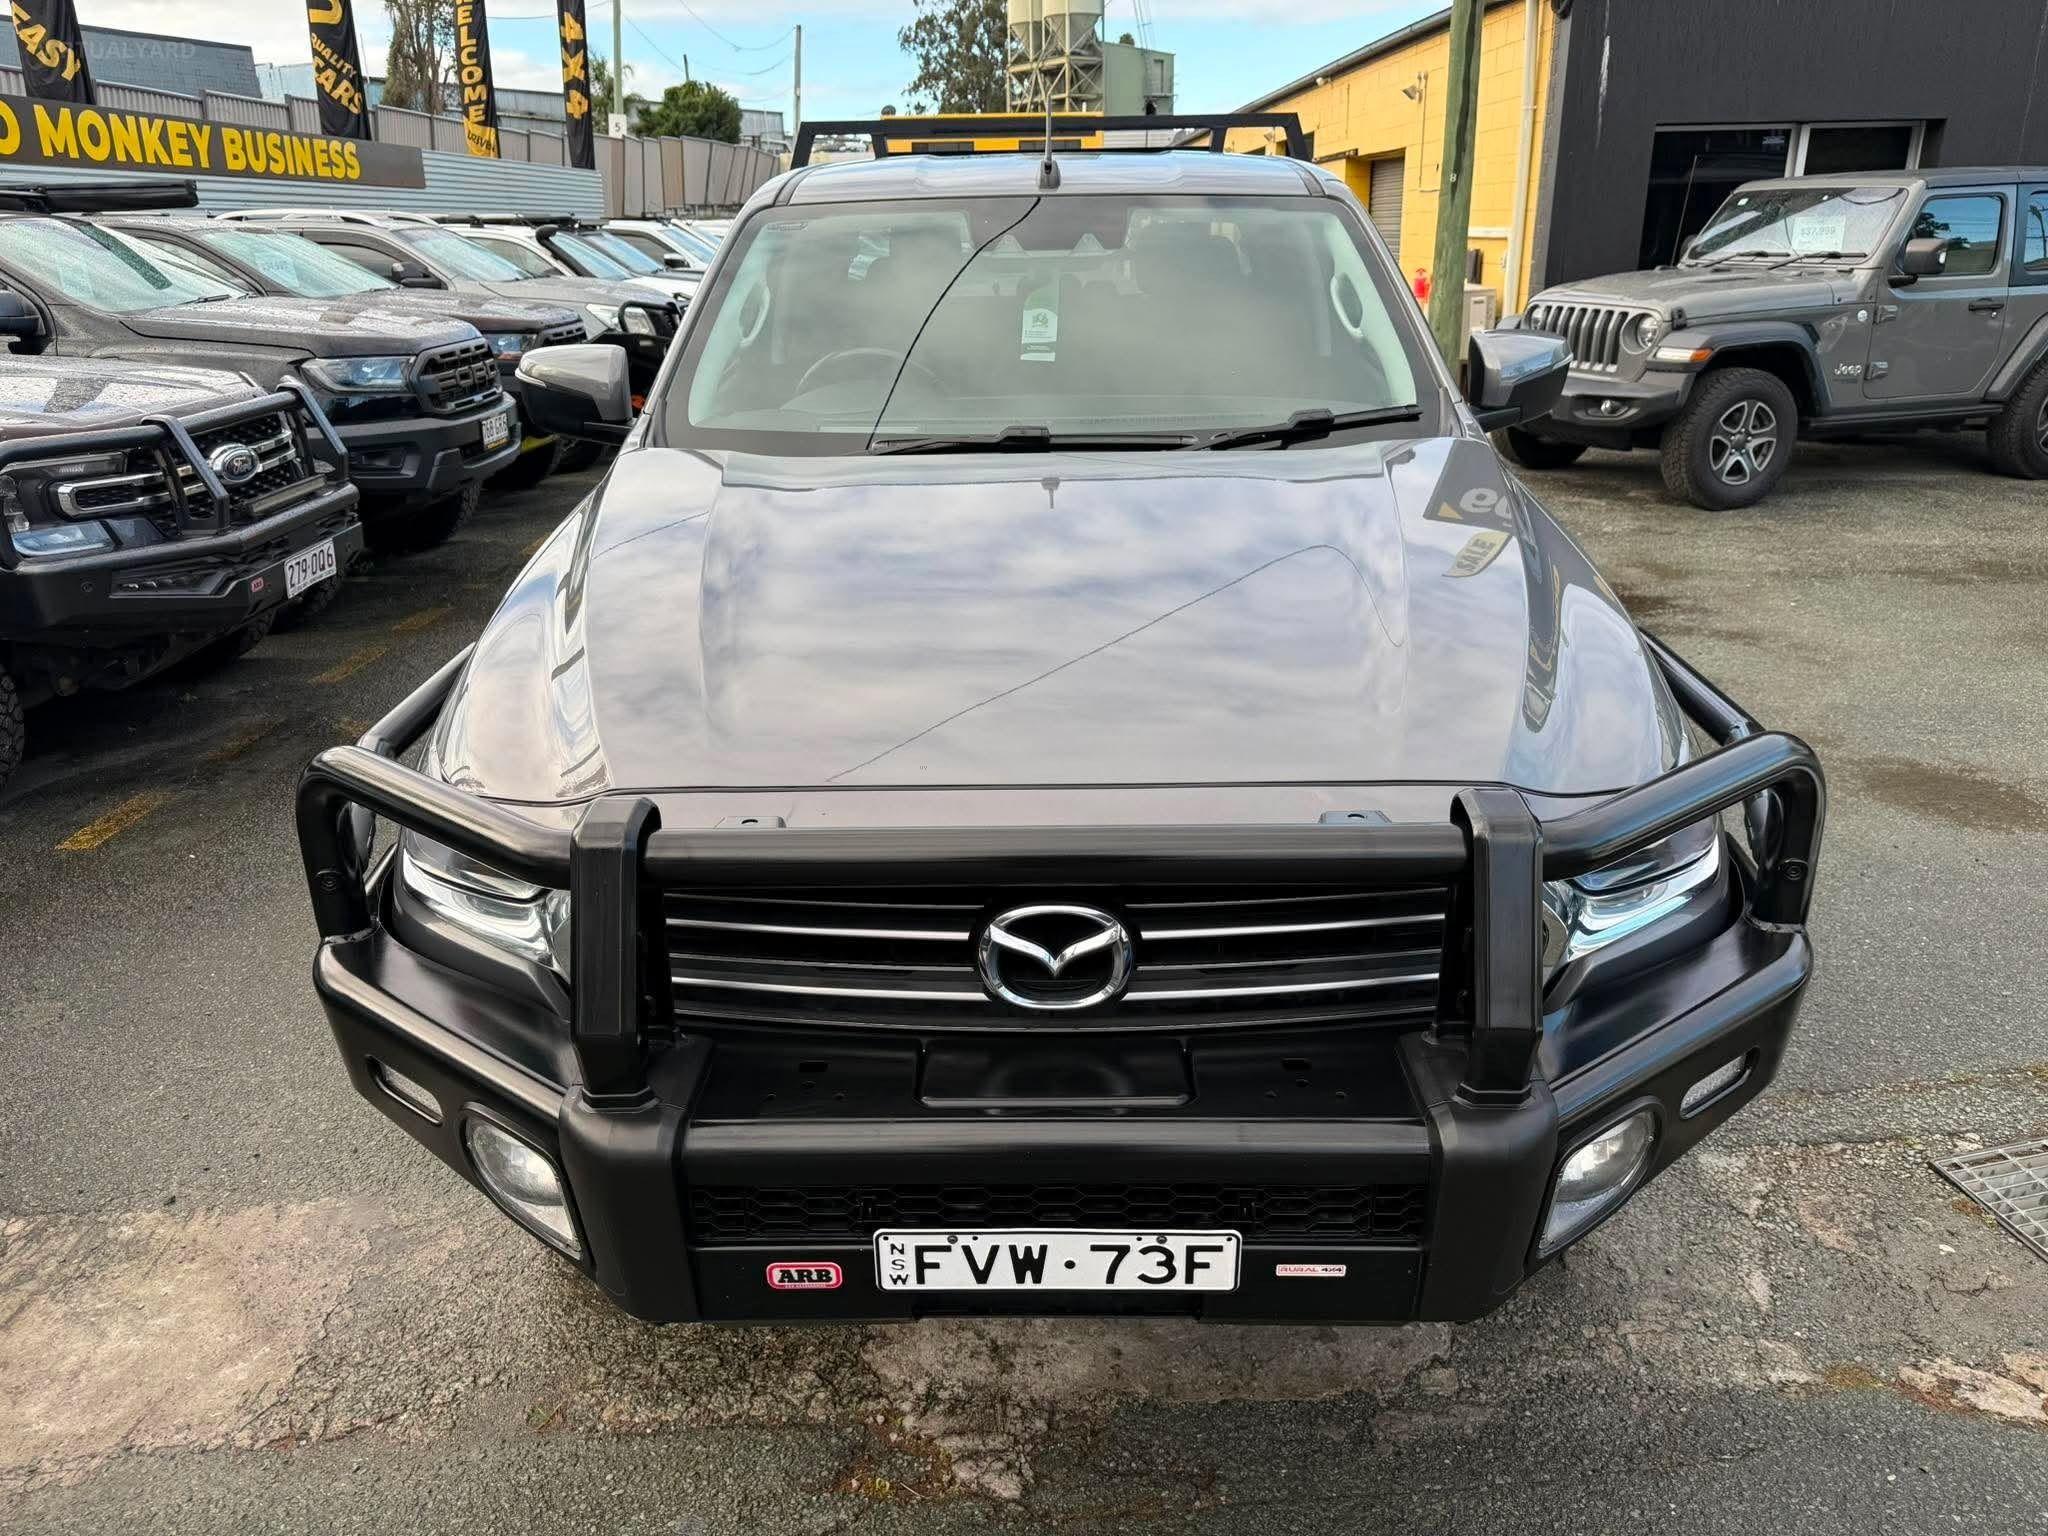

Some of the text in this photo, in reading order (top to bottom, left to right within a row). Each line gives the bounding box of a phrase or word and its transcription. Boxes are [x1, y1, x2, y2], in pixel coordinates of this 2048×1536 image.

[455, 0, 488, 123] ELCOME
[33, 103, 212, 169] MONKEY
[221, 127, 361, 180] BUSINESS
[1834, 362, 1862, 376] Jeep
[778, 1269, 833, 1283] ARB
[889, 1243, 909, 1285] NSW
